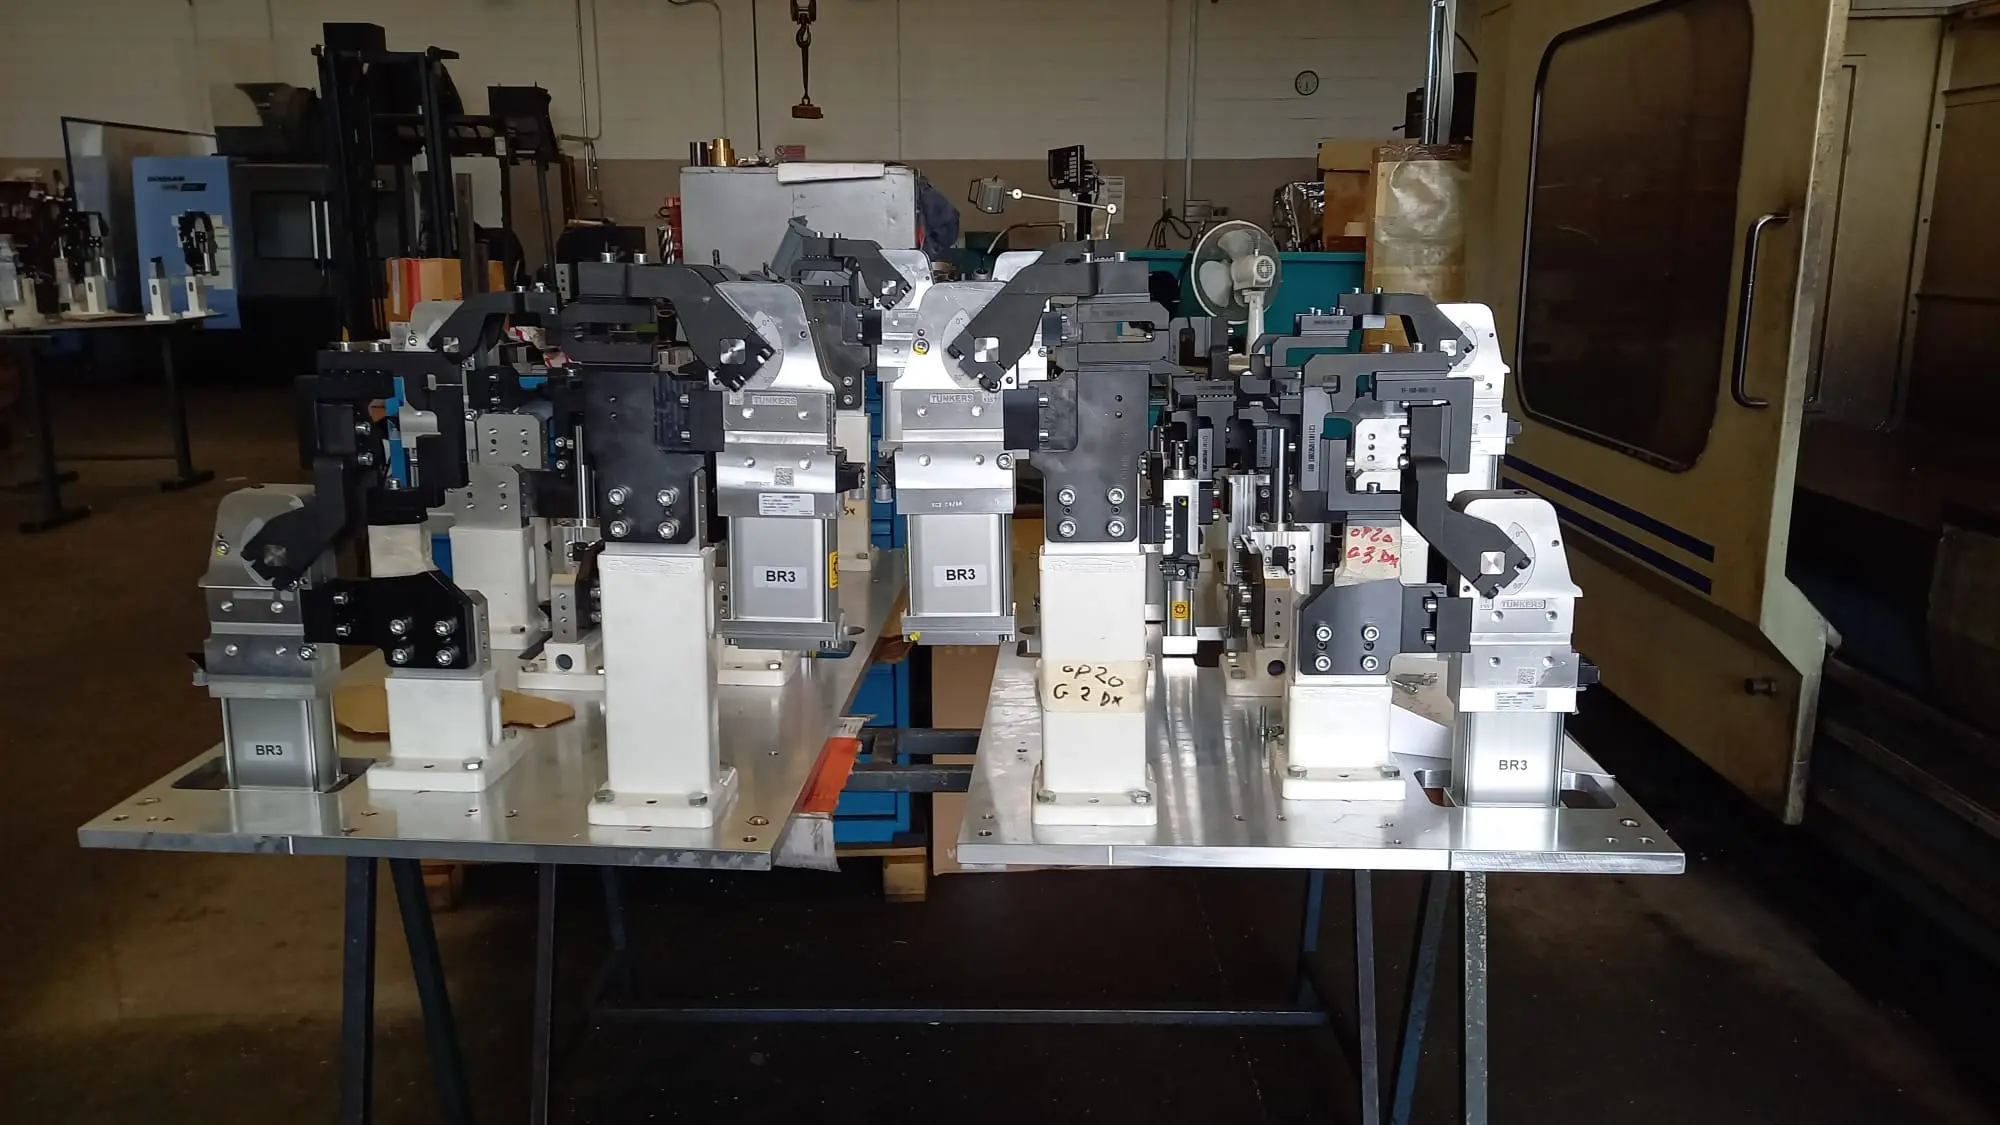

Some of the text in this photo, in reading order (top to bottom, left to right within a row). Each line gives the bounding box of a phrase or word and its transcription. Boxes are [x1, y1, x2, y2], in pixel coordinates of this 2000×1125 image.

[766, 570, 796, 582] BR3
[946, 568, 976, 581] BR3
[255, 744, 283, 756] BR3
[1499, 759, 1528, 770] BR3
